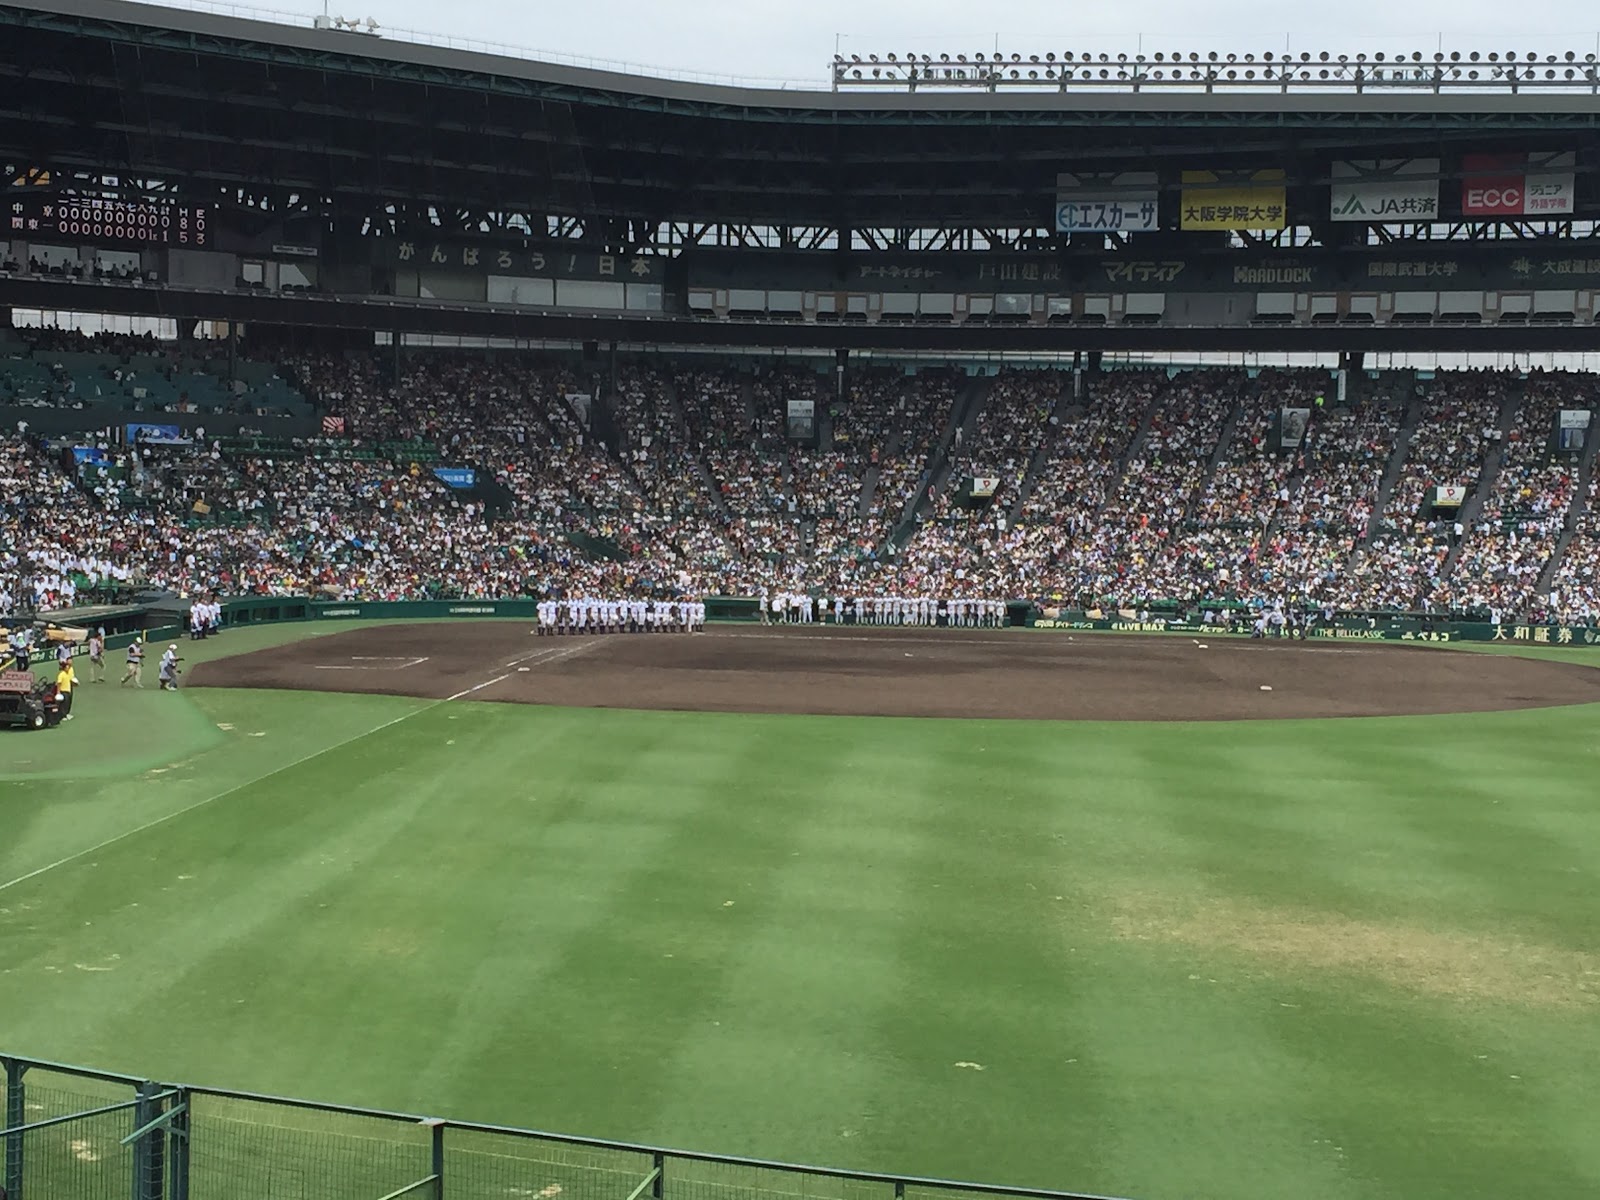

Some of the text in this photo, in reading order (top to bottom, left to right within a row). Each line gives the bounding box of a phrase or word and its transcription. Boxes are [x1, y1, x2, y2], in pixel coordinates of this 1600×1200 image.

[1371, 197, 1436, 215] JA共済
[1468, 188, 1520, 208] ECC
[179, 207, 188, 217] H
[196, 209, 205, 219] E
[1184, 205, 1282, 222] 大阪学院大学
[180, 217, 188, 230] 8
[196, 219, 205, 231] 0
[180, 231, 188, 243] 5
[196, 232, 205, 245] 3
[1101, 261, 1186, 282] マイティア
[1368, 261, 1458, 277] 国際武道大学
[1142, 623, 1165, 632] MAX
[1319, 628, 1334, 637] THE
[1492, 625, 1573, 644] 大和証券
